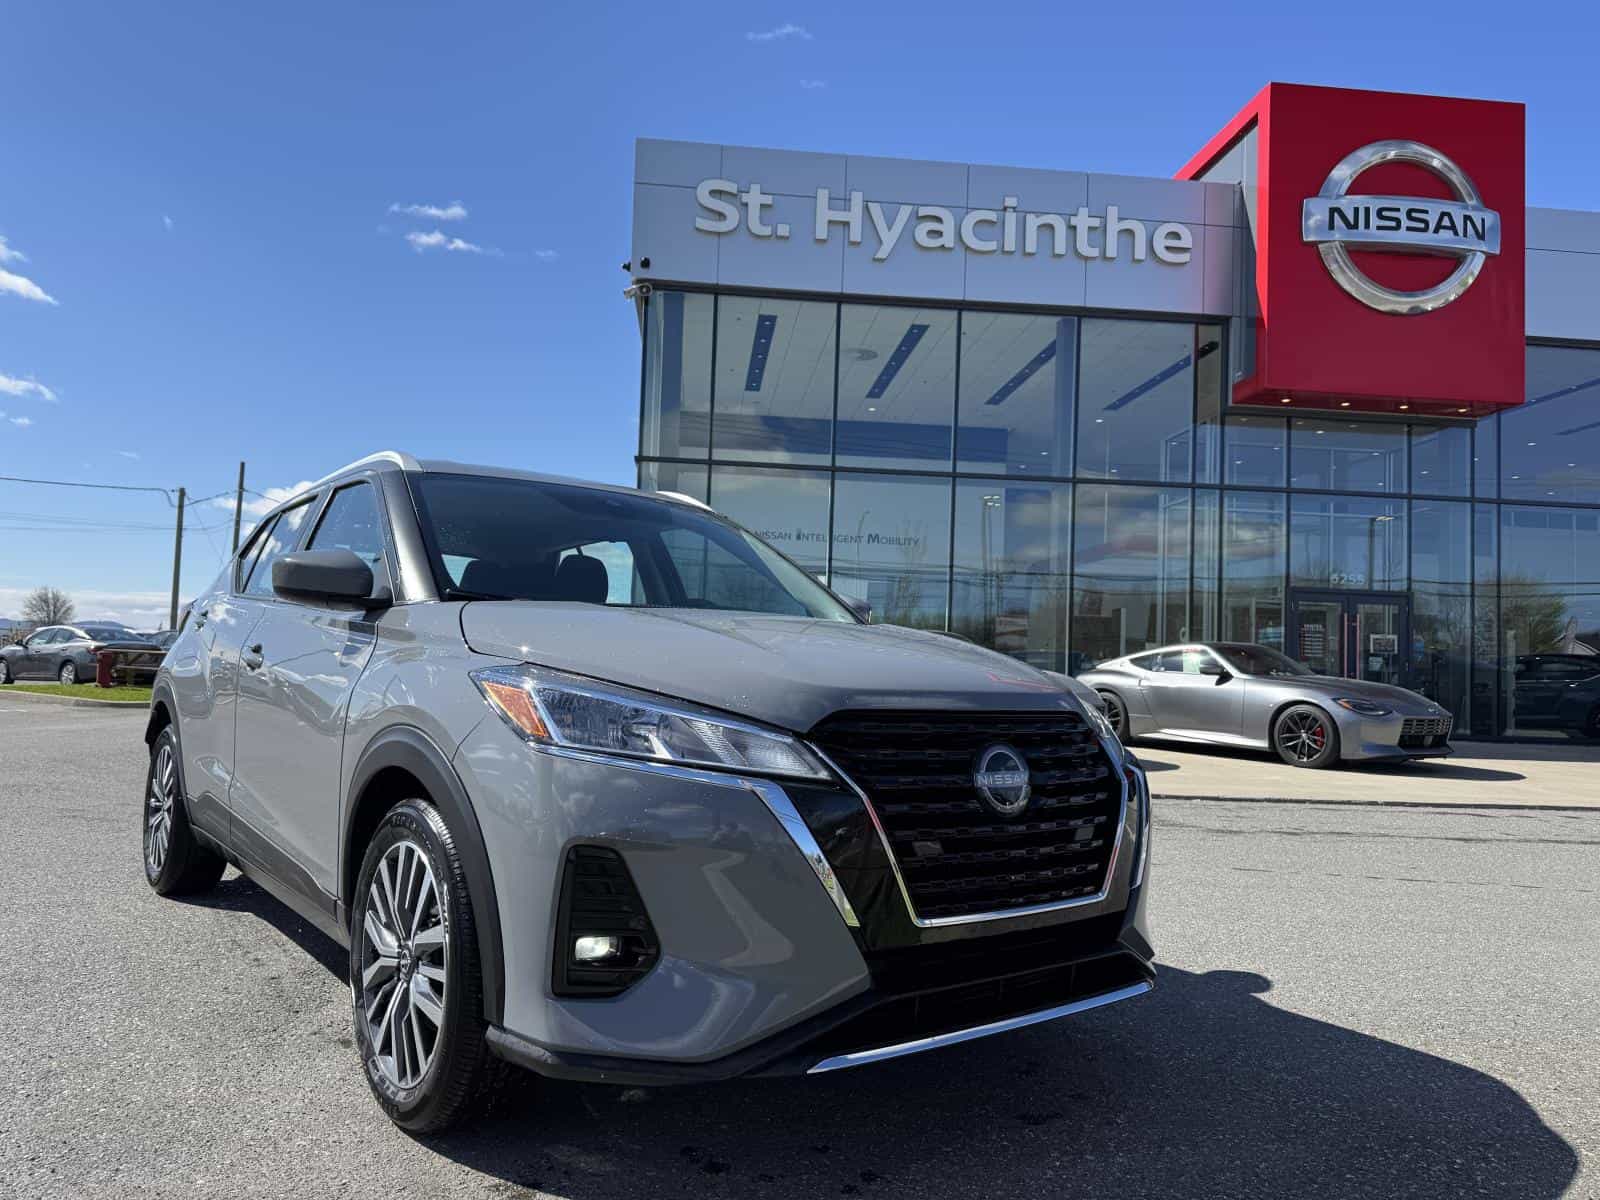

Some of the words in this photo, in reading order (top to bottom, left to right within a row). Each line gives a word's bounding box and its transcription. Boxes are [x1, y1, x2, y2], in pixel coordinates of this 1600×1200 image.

[695, 178, 791, 239] St.
[814, 187, 1193, 263] Hyacinthe
[1327, 206, 1486, 241] NISSAN
[796, 528, 864, 544] INTELIGENT
[976, 773, 1025, 786] NISSAN
